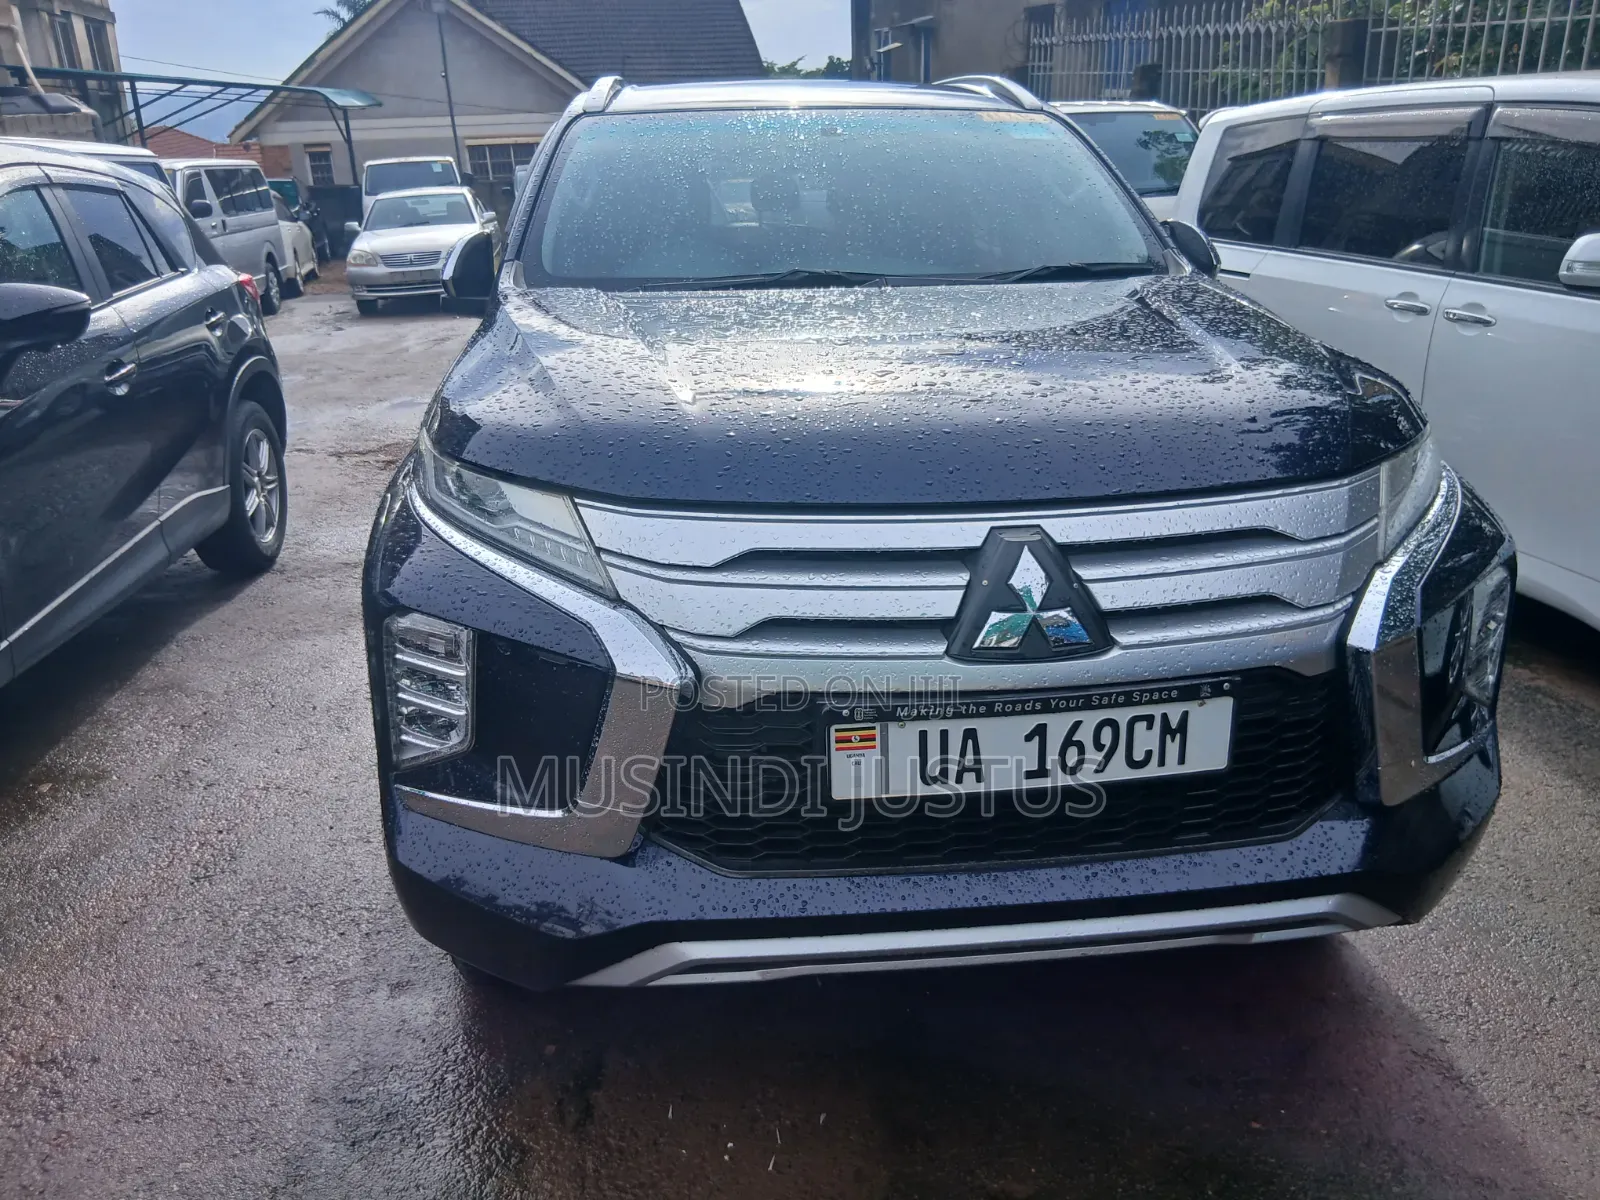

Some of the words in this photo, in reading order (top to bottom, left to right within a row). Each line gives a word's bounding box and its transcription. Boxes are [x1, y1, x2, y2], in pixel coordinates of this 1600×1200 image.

[895, 703, 954, 718] Making
[962, 703, 987, 715] the
[994, 699, 1042, 713] Roads
[1050, 698, 1085, 709] Your
[1091, 693, 1125, 706] Safe
[1132, 688, 1178, 704] Space
[917, 727, 986, 787] UA
[1022, 708, 1190, 781] 169CM
